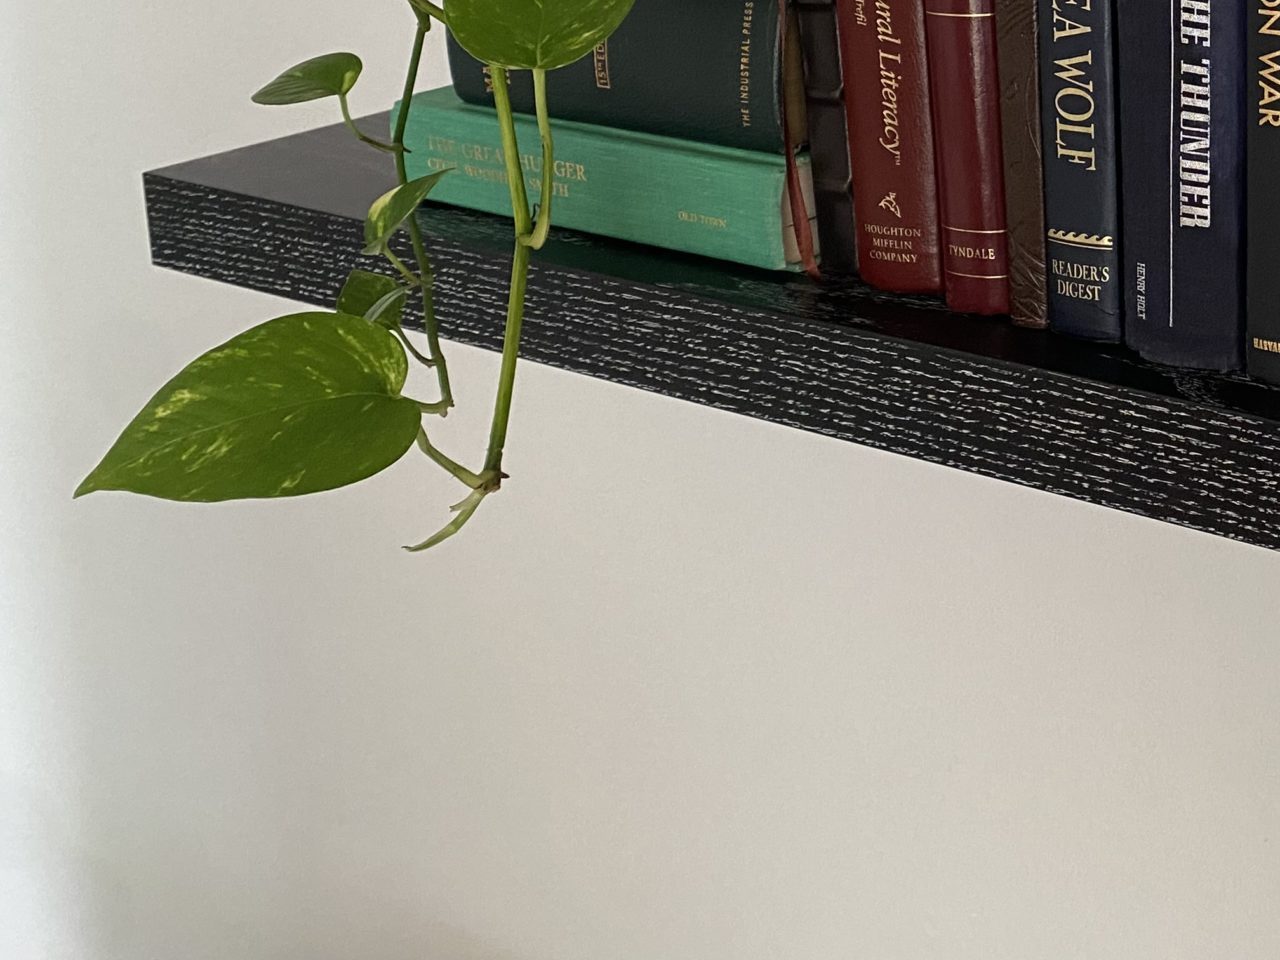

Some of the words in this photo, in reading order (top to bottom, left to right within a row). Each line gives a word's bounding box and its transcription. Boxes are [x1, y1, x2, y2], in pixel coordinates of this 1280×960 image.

[742, 1, 754, 35] PRESS
[740, 38, 750, 104] INDUSTRIAL
[741, 109, 751, 128] THE
[1053, 50, 1097, 171] WOLF
[1179, 58, 1211, 228] THUNDER
[461, 143, 505, 165] GREA
[519, 154, 588, 182] HUGER
[864, 224, 920, 237] HOUGHTON
[873, 238, 912, 250] MIFFLIN
[949, 244, 996, 259] TYNDALE
[870, 250, 918, 263] COMPANY
[1051, 258, 1110, 282] READER'S
[1057, 279, 1102, 301] DIGEST
[1136, 294, 1146, 321] HOLT
